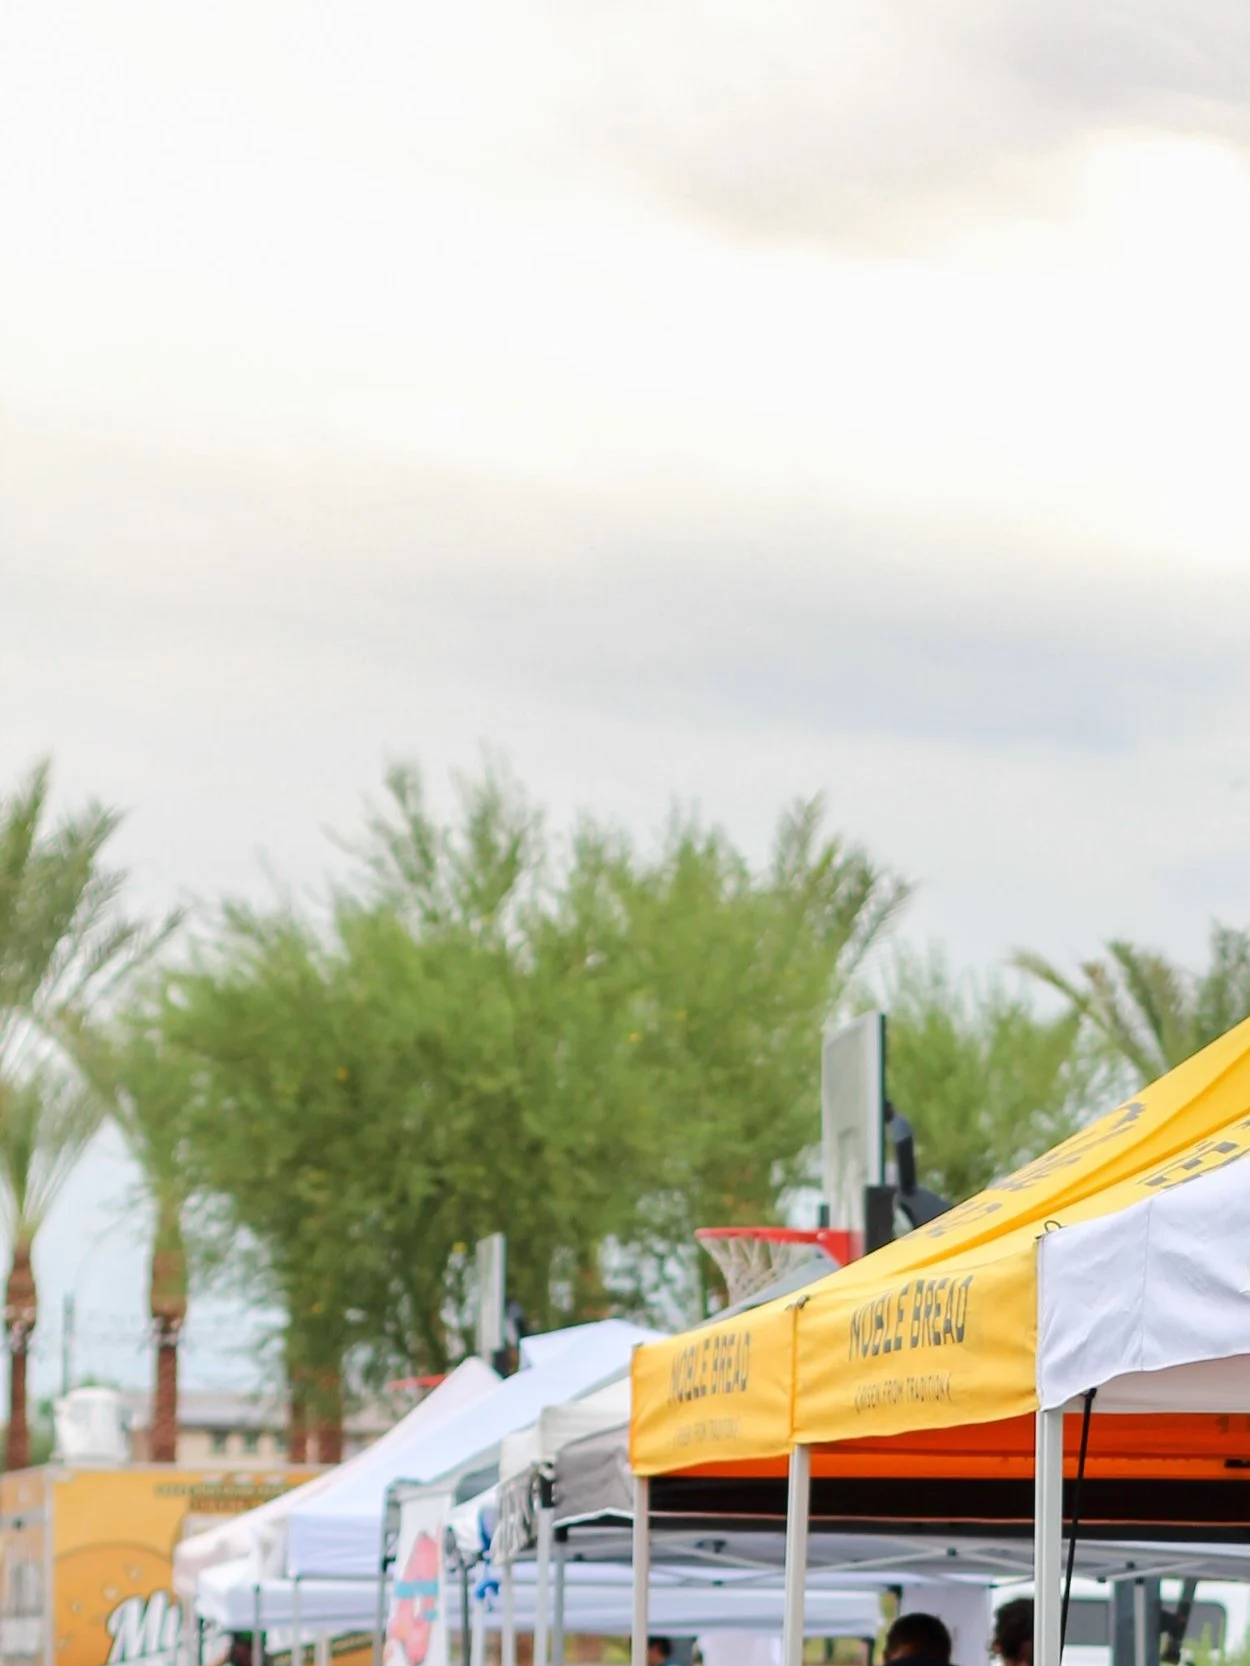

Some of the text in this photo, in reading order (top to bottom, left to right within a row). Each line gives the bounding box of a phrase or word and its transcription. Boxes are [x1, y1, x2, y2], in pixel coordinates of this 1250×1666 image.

[849, 1275, 973, 1362] NOBLE BREAD
[667, 1331, 750, 1408] NOBLE BREAD
